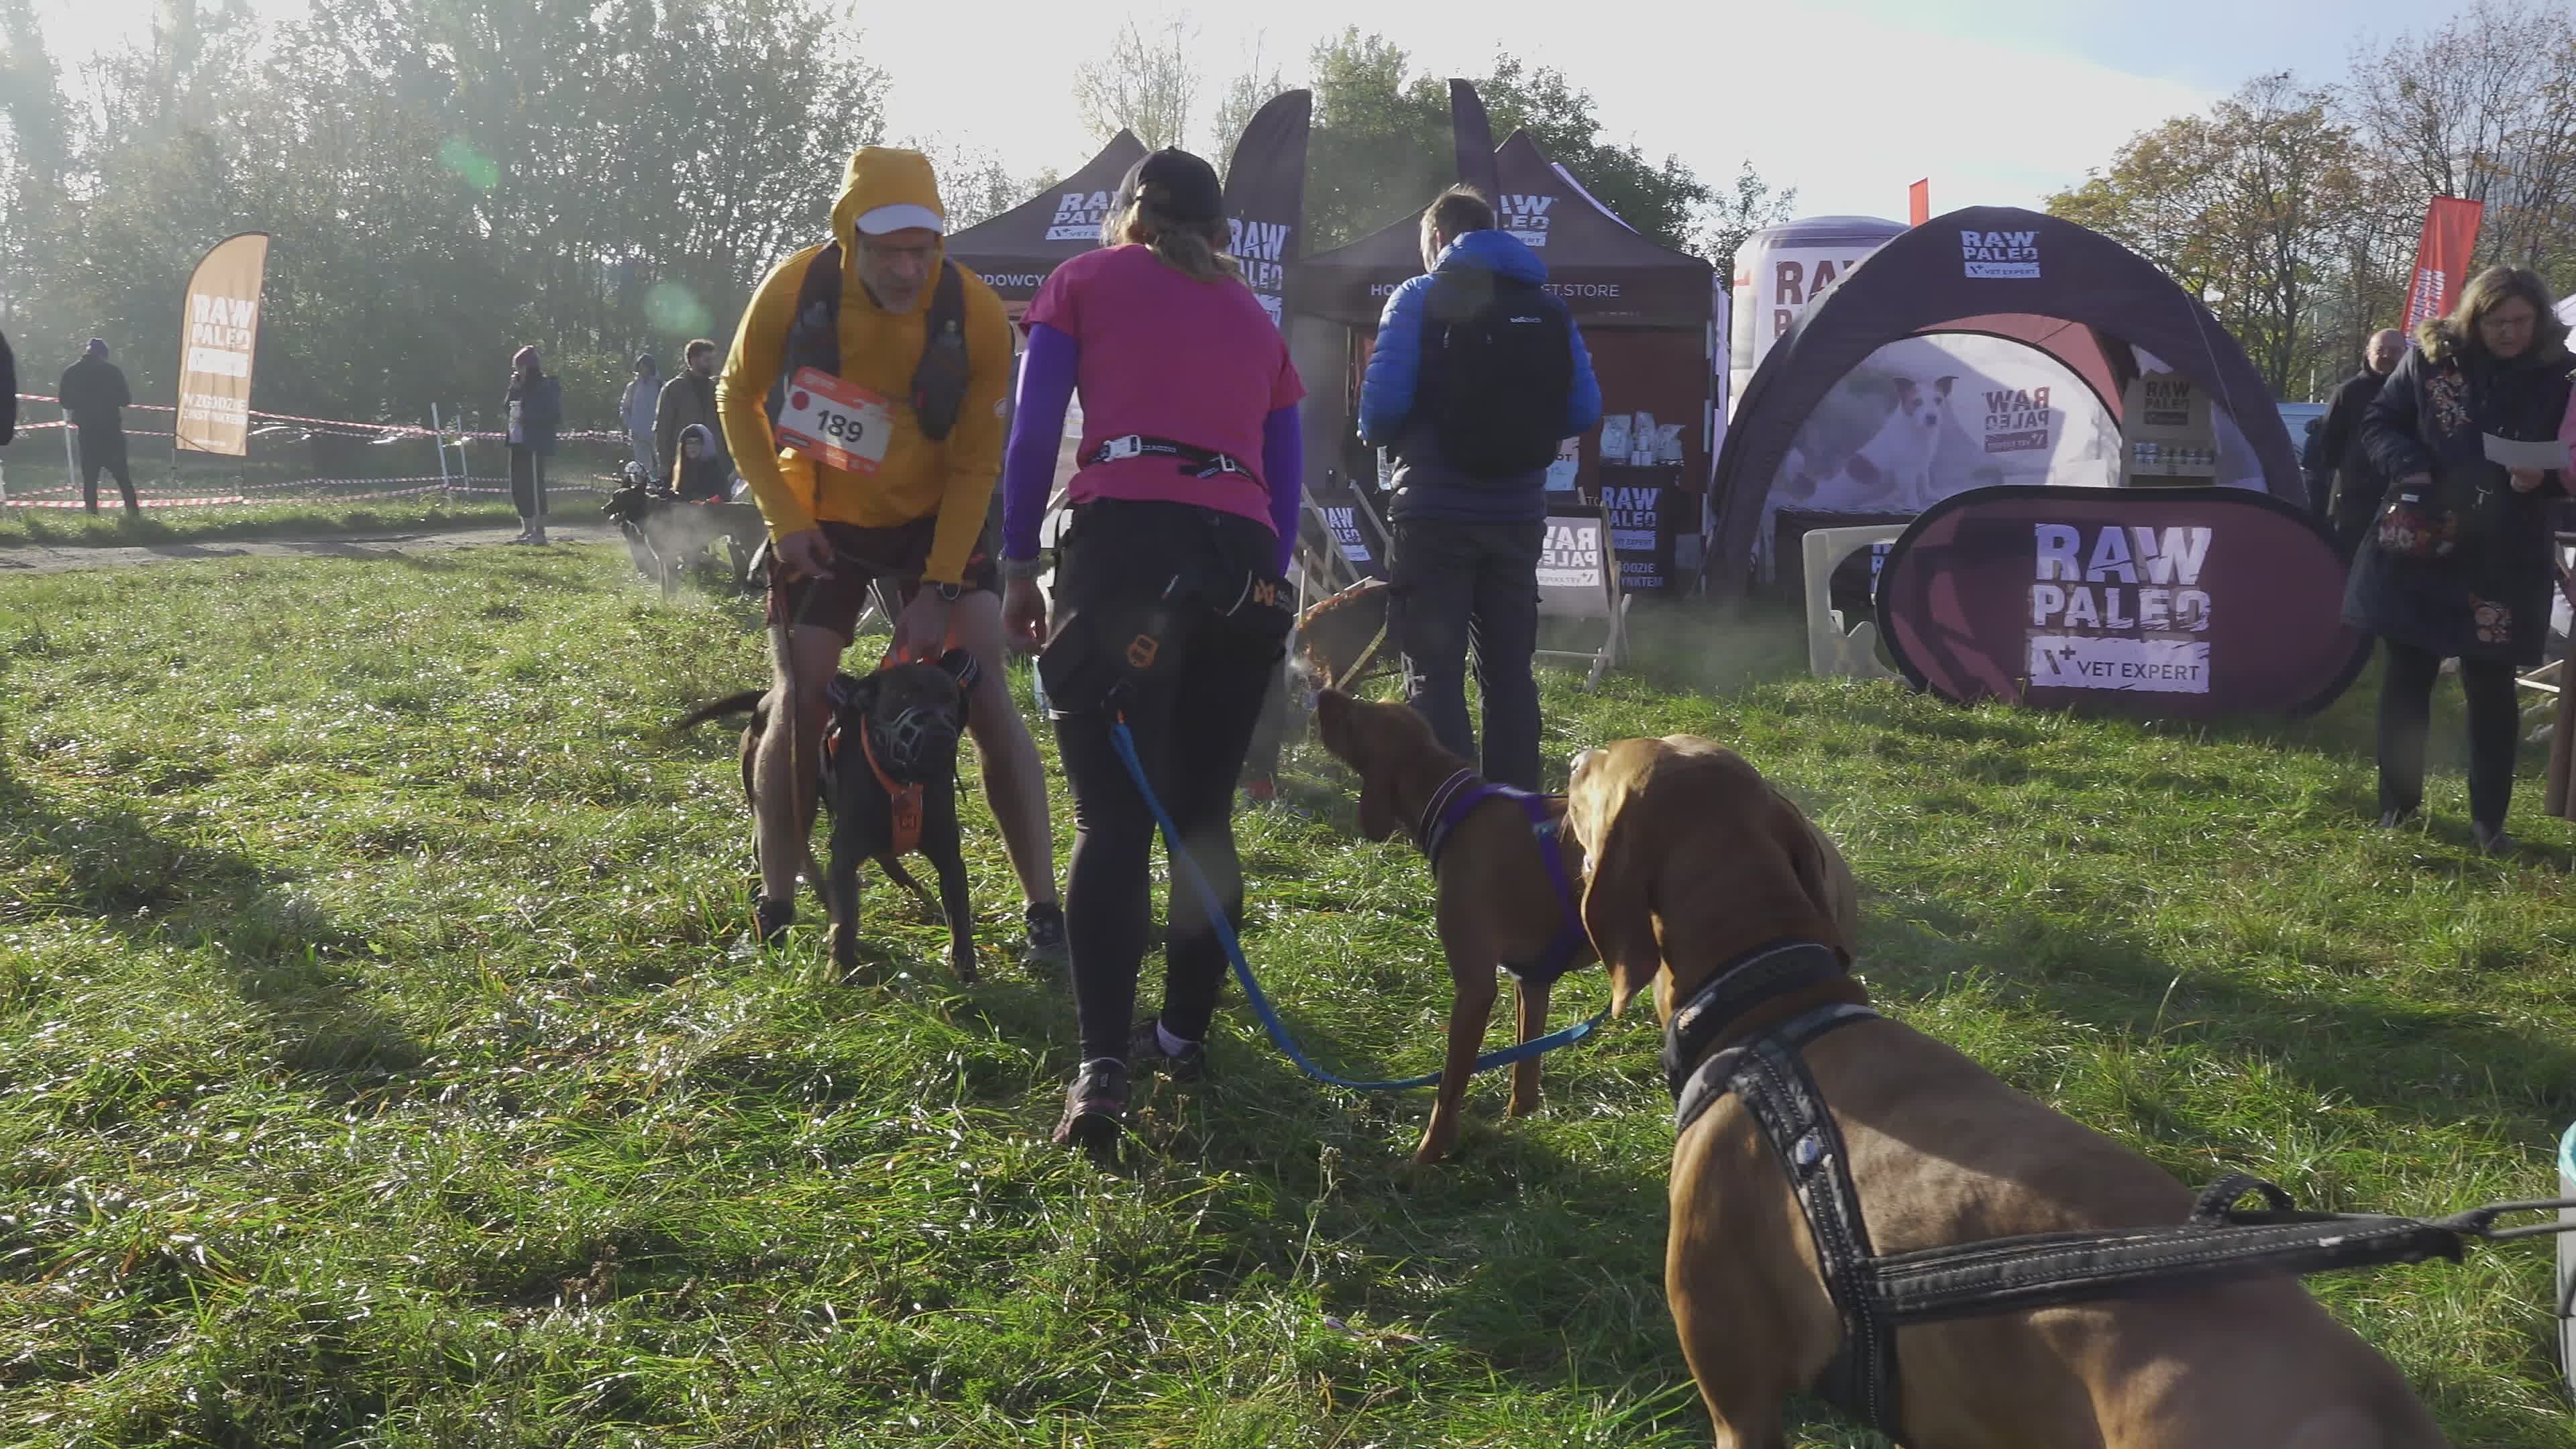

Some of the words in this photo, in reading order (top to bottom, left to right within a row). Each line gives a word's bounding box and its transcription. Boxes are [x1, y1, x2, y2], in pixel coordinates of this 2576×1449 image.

[1053, 211, 1101, 224] PAL
[1960, 231, 2035, 247] RAW
[1962, 246, 2039, 260] PALEO
[1370, 284, 1401, 296] HO
[1776, 260, 1856, 305] RA
[193, 294, 255, 329] RAW
[816, 410, 863, 443] 189
[1601, 486, 1658, 511] RAW
[1610, 511, 1656, 527] ALEO
[2034, 523, 2212, 586] RAW
[2031, 584, 2212, 632] PALEO
[2077, 661, 2115, 677] VET
[2121, 662, 2200, 680] EXPERT
